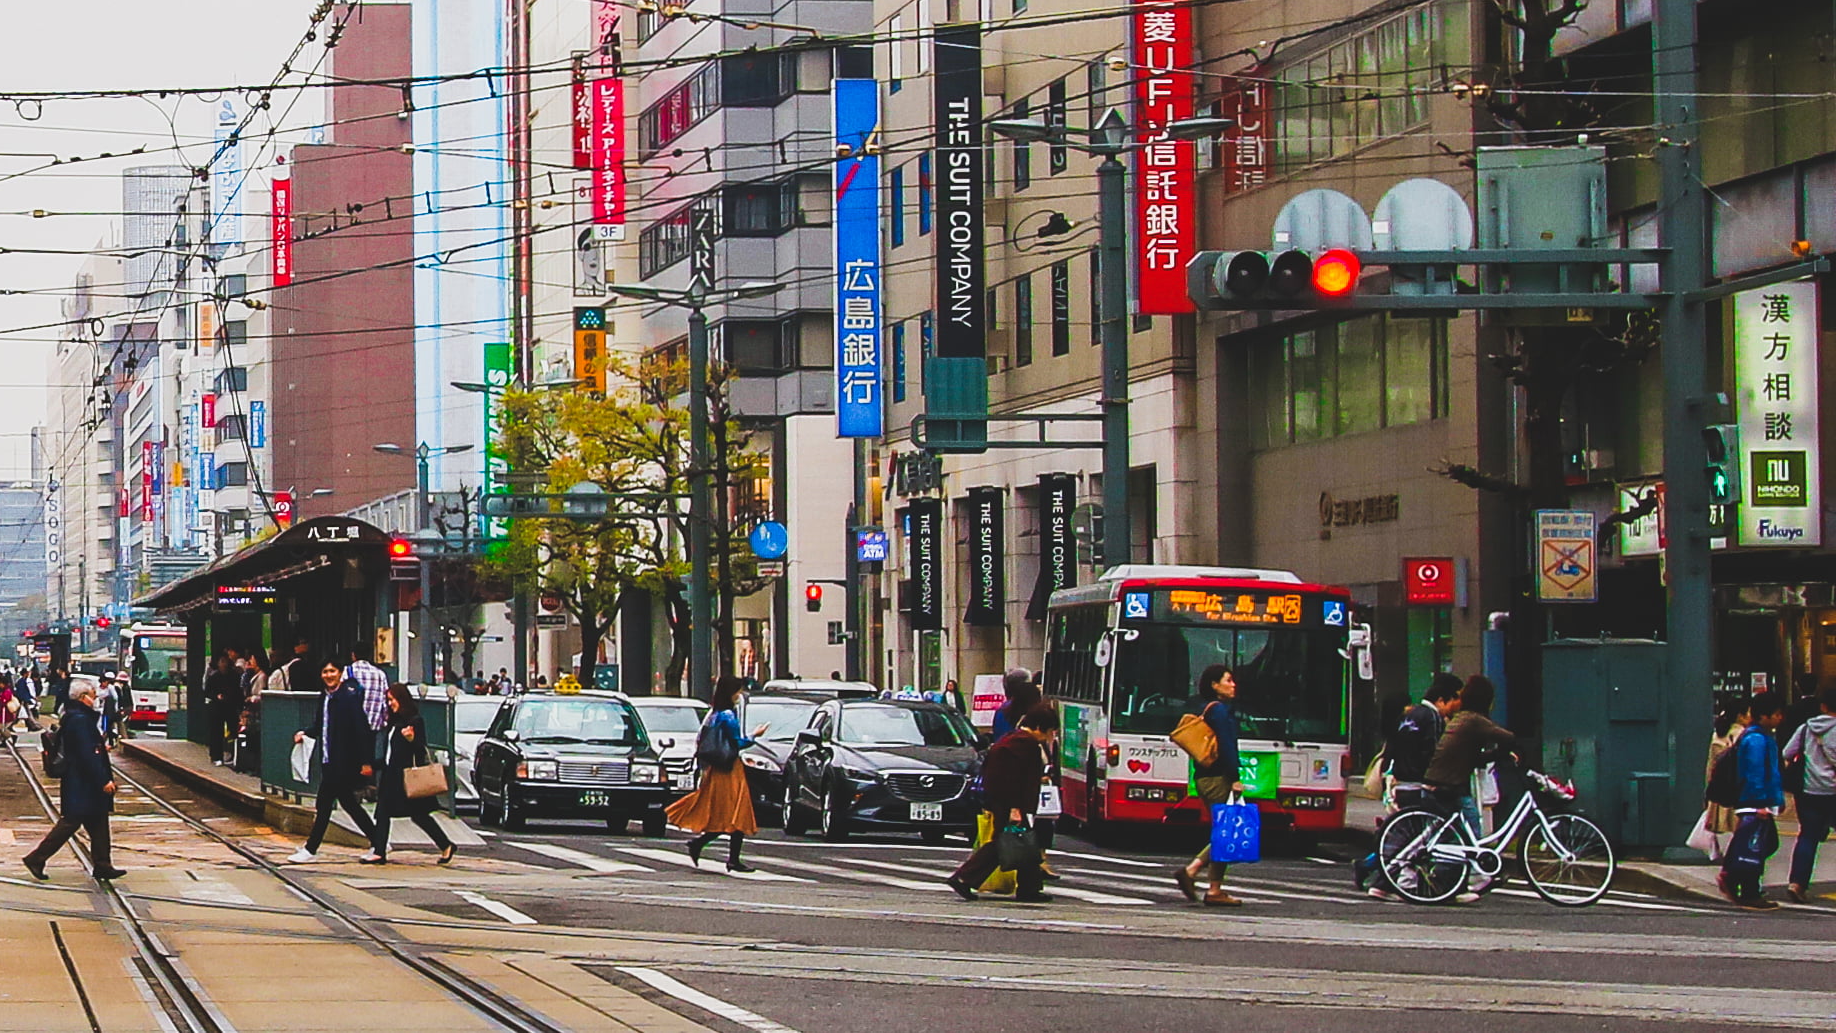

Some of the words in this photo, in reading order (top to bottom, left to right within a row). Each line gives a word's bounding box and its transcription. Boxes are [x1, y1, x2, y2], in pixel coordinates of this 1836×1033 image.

[948, 97, 970, 145] THE
[948, 152, 971, 206] SUIT
[600, 227, 617, 237] 3F
[949, 211, 972, 328] COMPANY
[842, 258, 877, 405] 広島銀行
[1761, 293, 1792, 442] 漢方相談
[980, 502, 991, 525] THE
[1052, 489, 1063, 512] THE
[48, 500, 59, 563] SOGO
[307, 525, 360, 539] 八丁堀
[920, 514, 931, 535] THE
[1052, 515, 1064, 545] SUIT
[1758, 518, 1804, 541] Fukuya
[863, 549, 885, 559] ATM
[920, 538, 932, 561] SUIT
[980, 527, 992, 553] SUIT
[981, 555, 994, 610] COMPANY
[1052, 547, 1065, 591] COMPA
[920, 564, 932, 615] COMPANY
[1128, 747, 1180, 758] ワンステップバス
